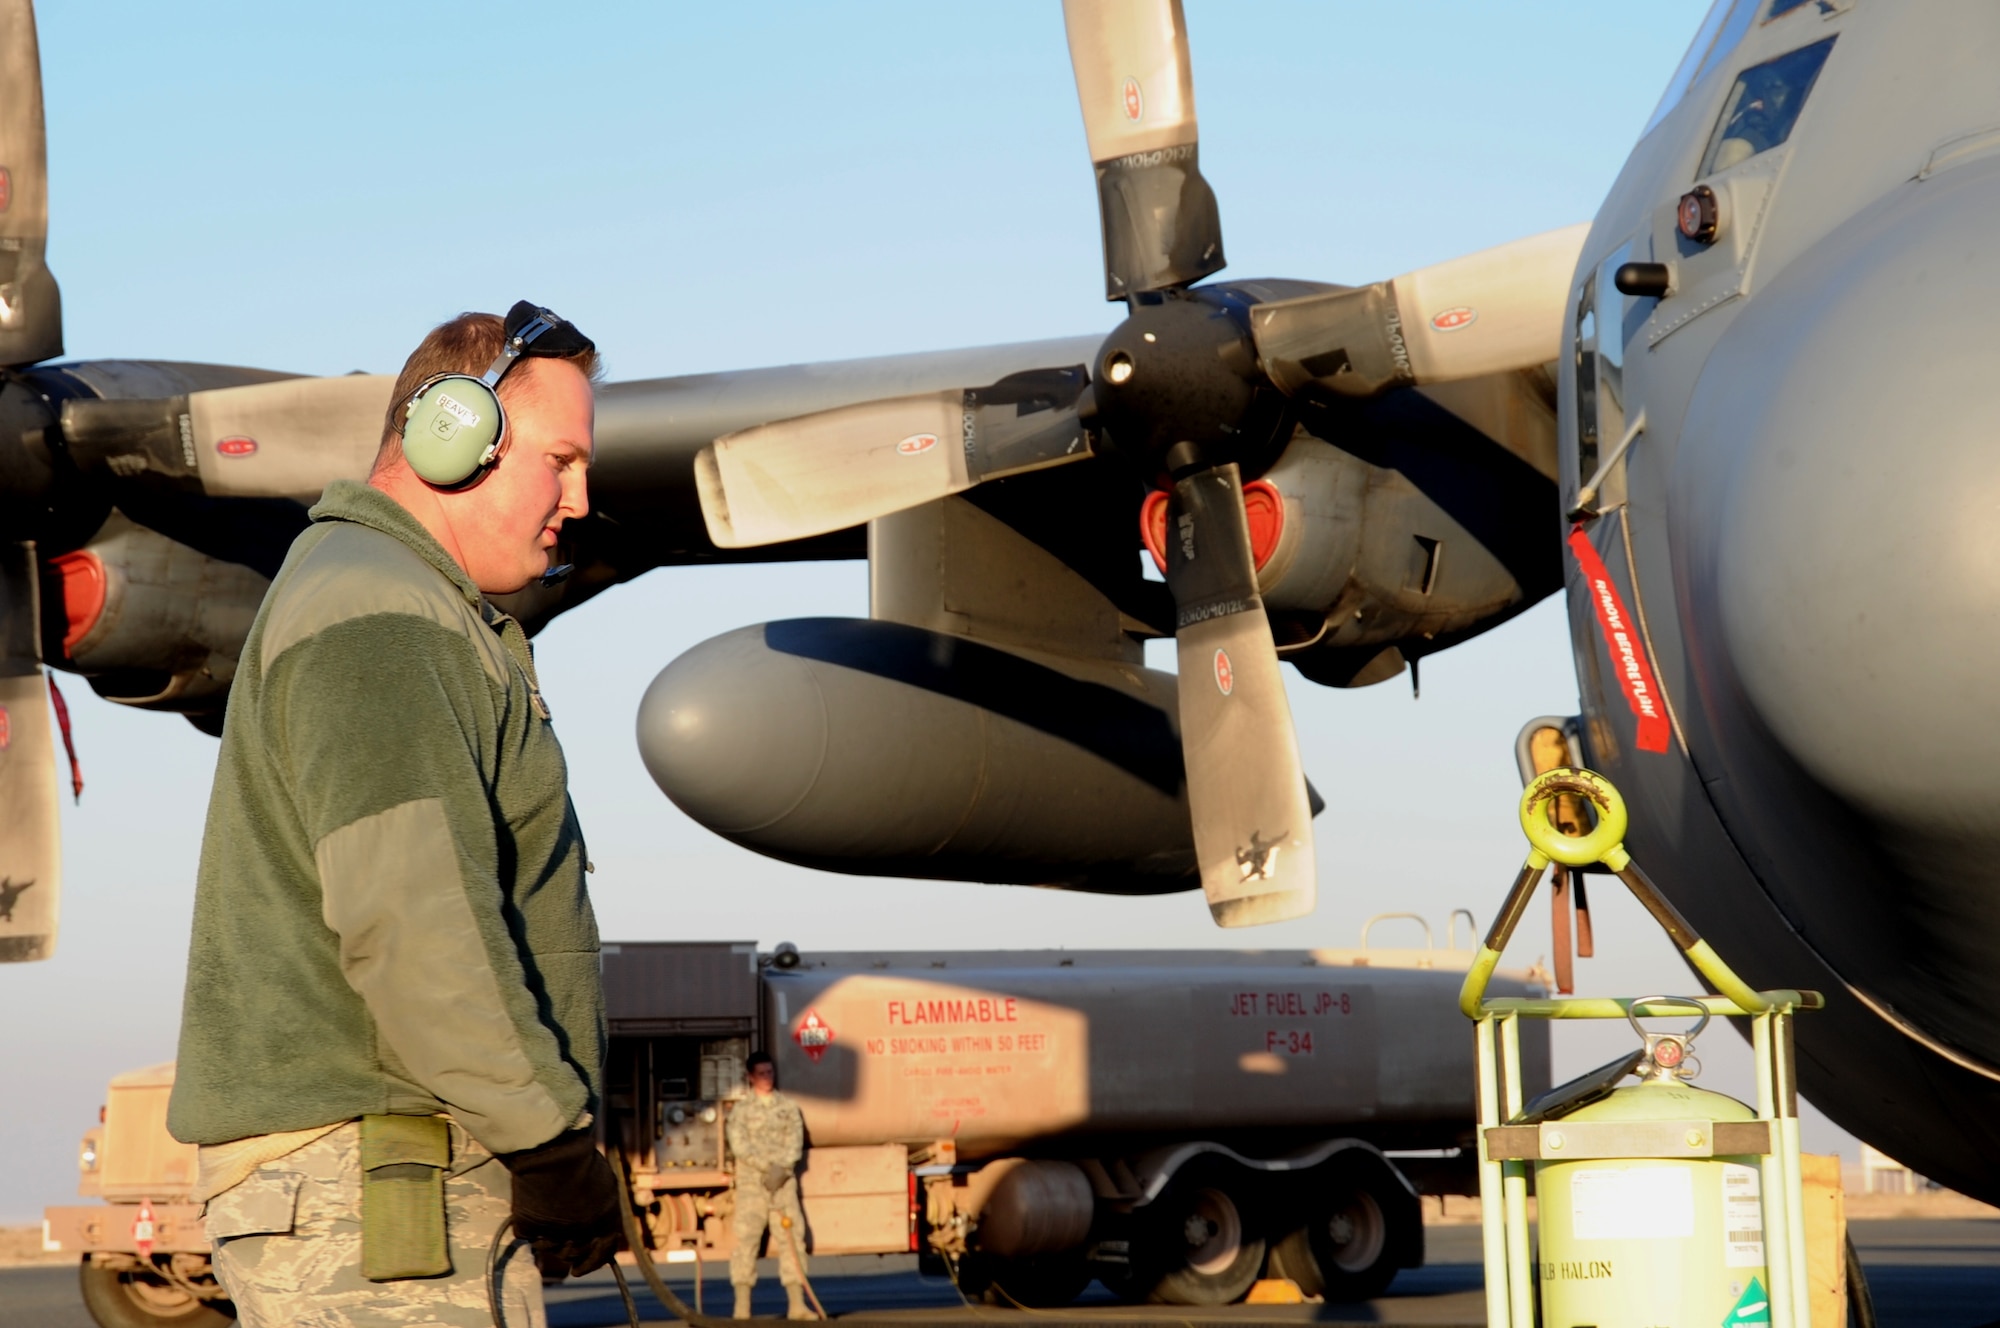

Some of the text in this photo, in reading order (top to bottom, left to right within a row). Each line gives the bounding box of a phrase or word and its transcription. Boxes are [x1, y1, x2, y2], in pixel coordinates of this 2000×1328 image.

[1595, 579, 1624, 629] REMOVE
[1614, 632, 1641, 680] BEFORE
[888, 998, 1018, 1025] FLAMMABLE
[1230, 992, 1351, 1016] JET FUEL JP-8
[867, 1034, 1046, 1055] NO SMOKING WITHIN 50 FEET
[1266, 1031, 1312, 1055] F-34
[1561, 1261, 1611, 1279] HALON
